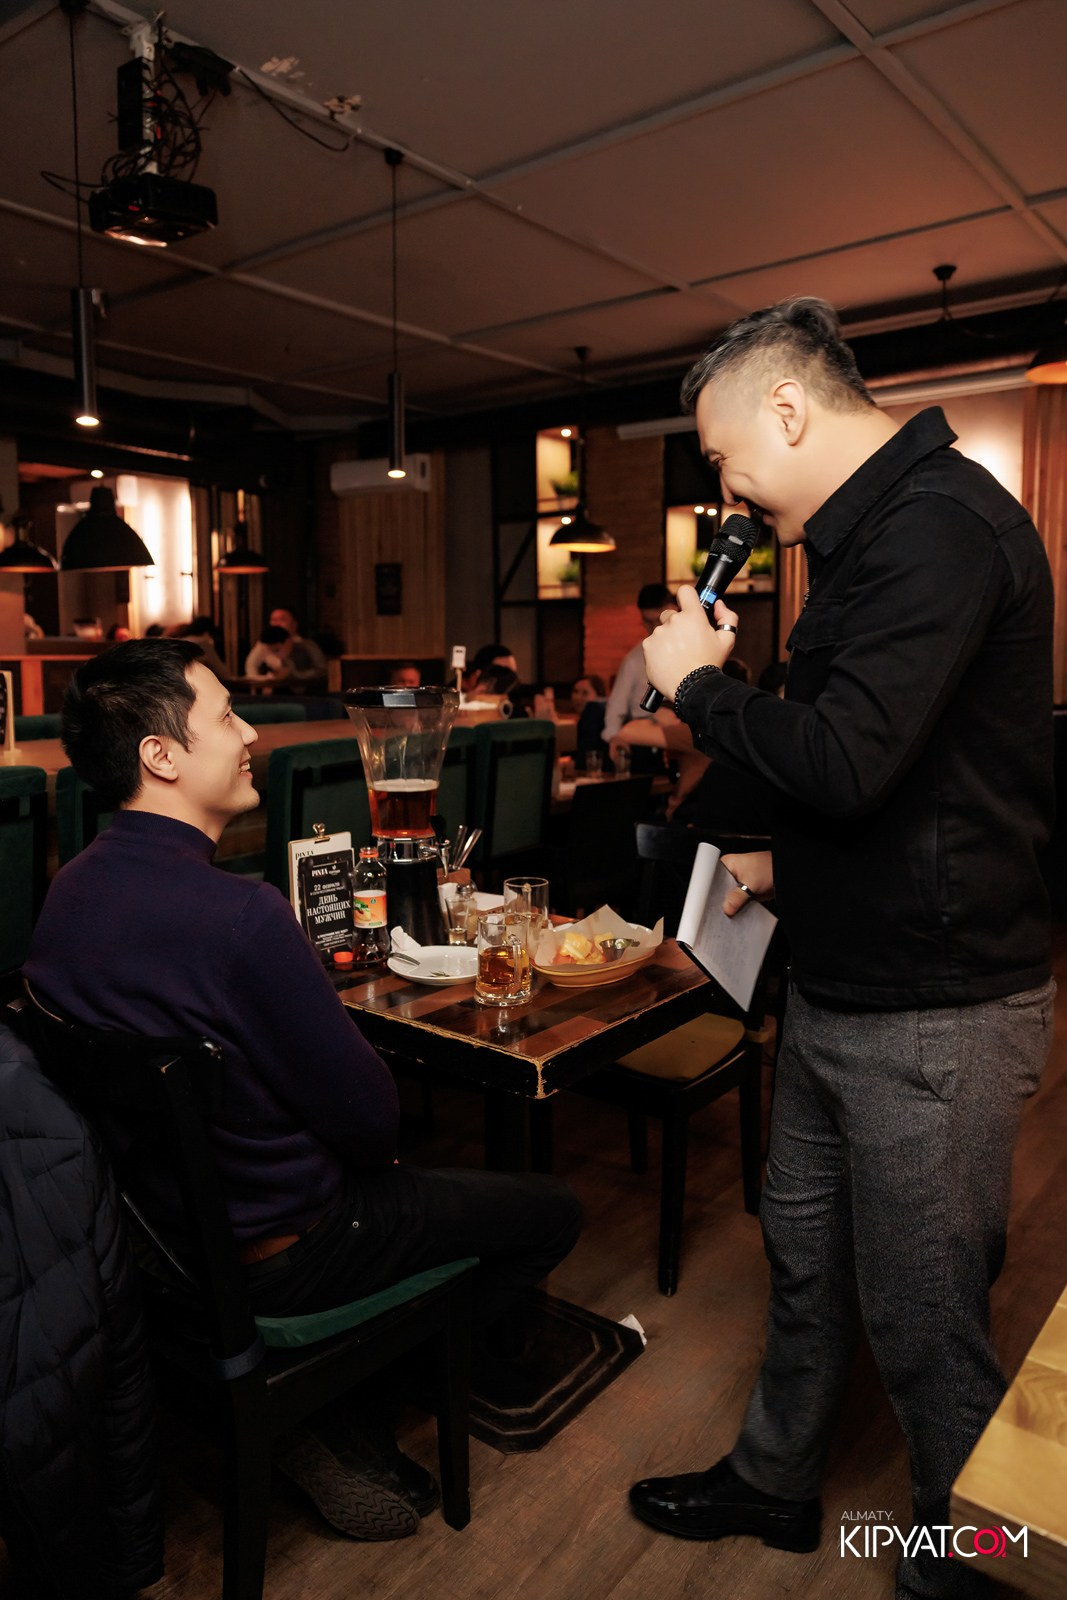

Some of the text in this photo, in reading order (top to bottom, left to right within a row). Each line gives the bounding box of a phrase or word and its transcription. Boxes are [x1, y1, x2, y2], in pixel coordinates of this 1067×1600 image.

[312, 868, 328, 876] PINTA
[318, 894, 338, 906] ДЕНЬ
[306, 900, 351, 917] НАСТОЯЩИХ
[314, 910, 346, 925] МУЖЧИН
